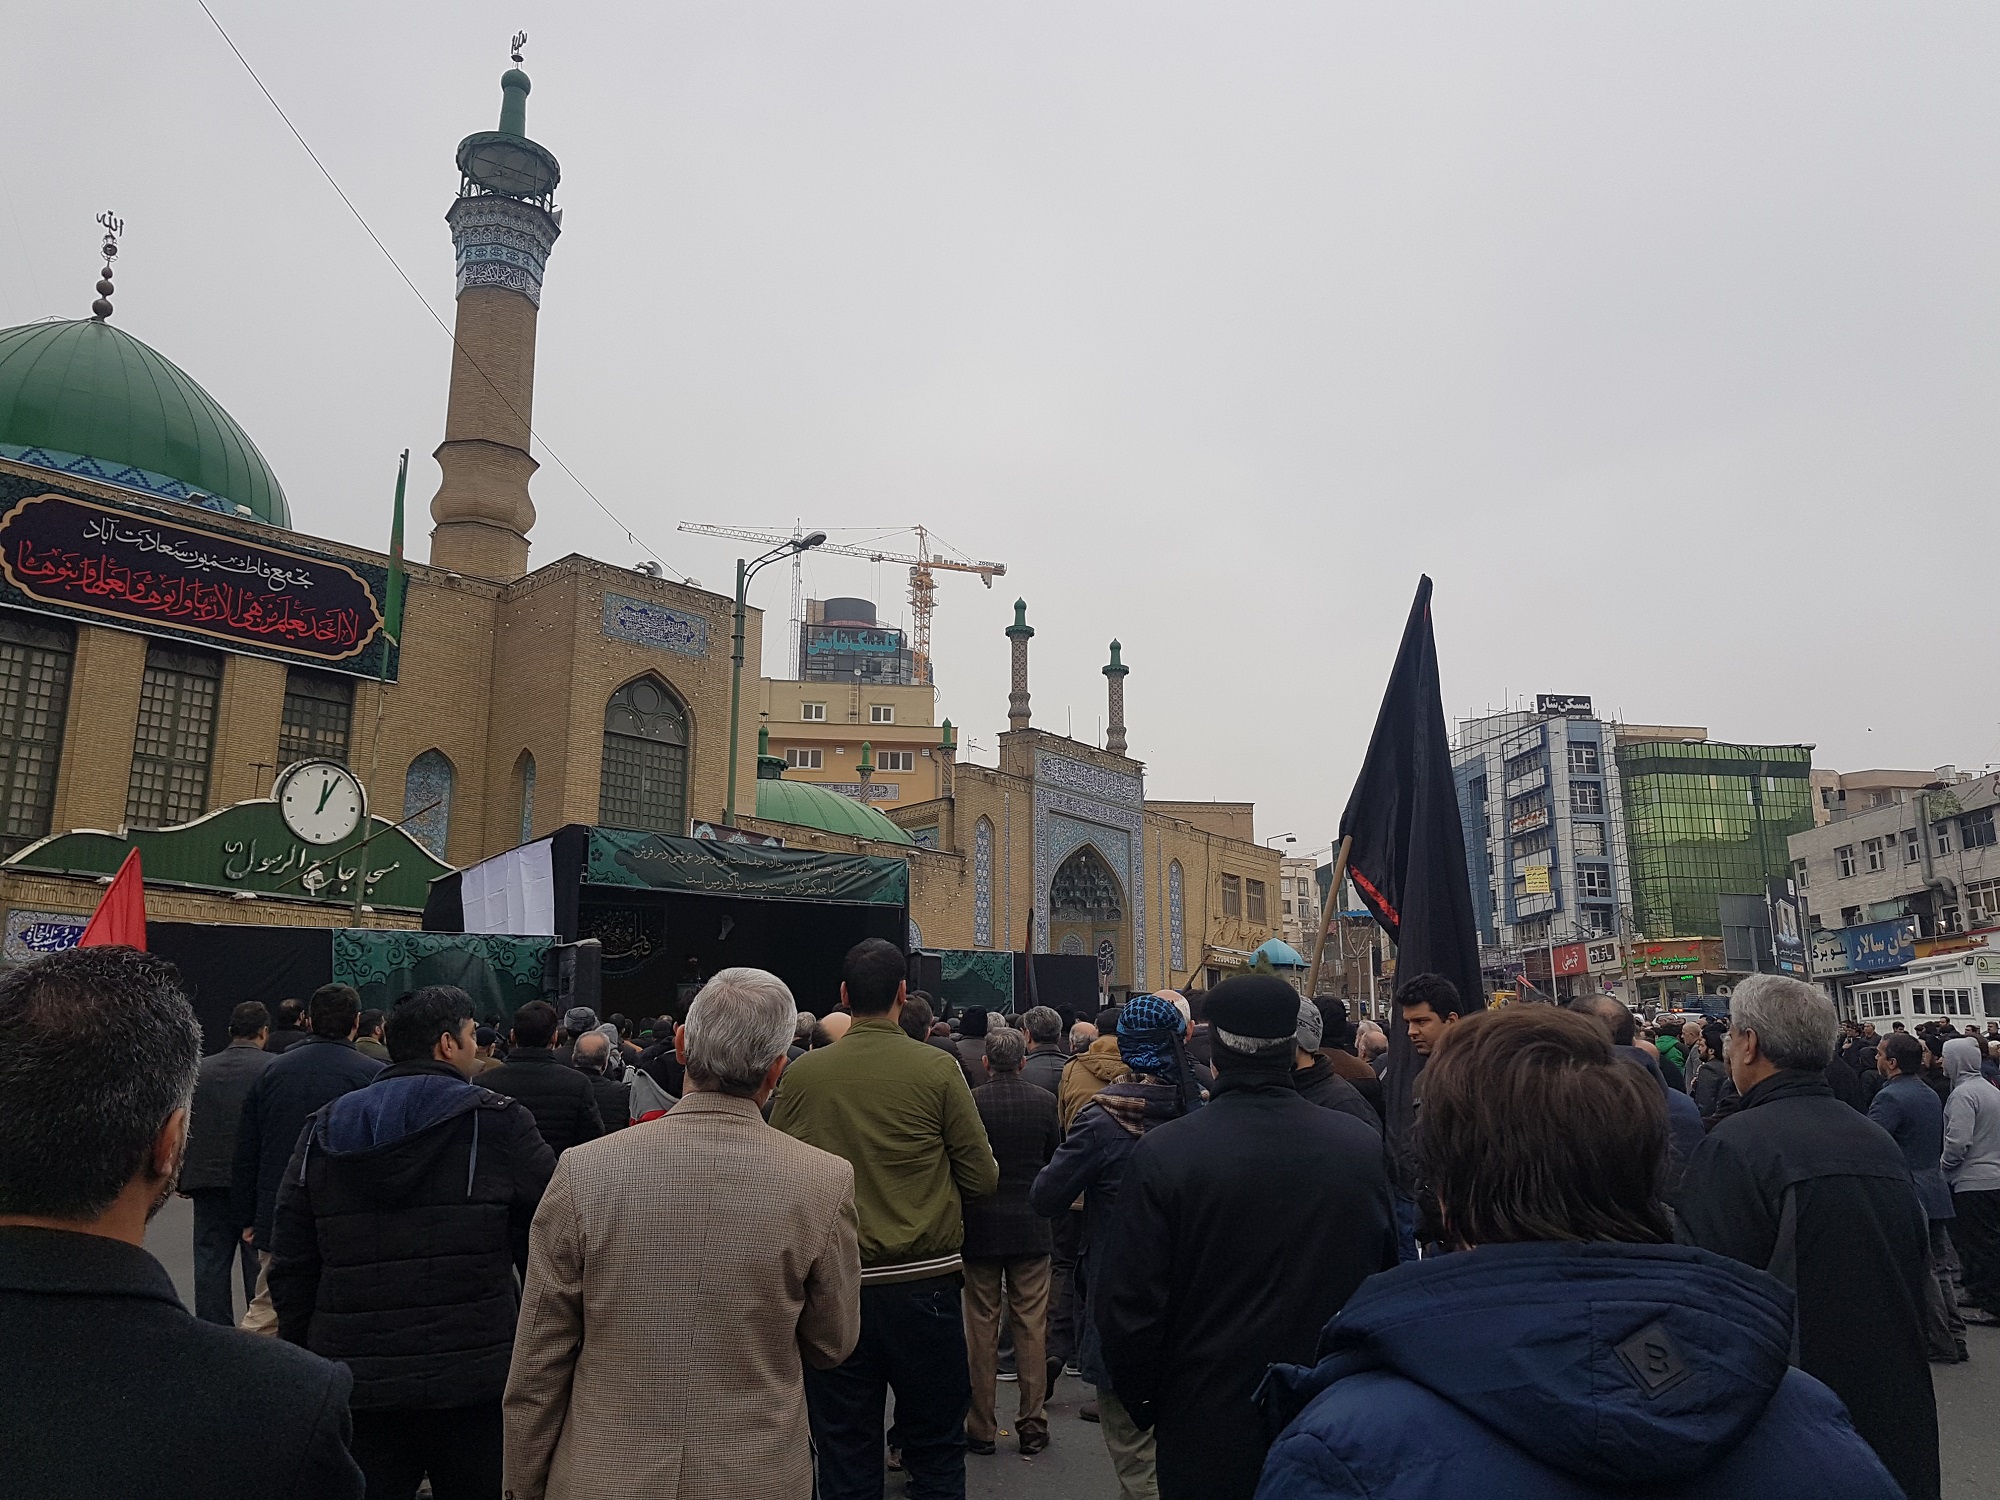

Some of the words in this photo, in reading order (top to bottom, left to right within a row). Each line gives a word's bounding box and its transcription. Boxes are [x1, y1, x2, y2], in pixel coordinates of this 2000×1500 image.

[83, 517, 119, 545] آباد
[1557, 698, 1591, 712] مسکن
[226, 839, 306, 880] الرسول
[1855, 933, 1885, 961] سالار
